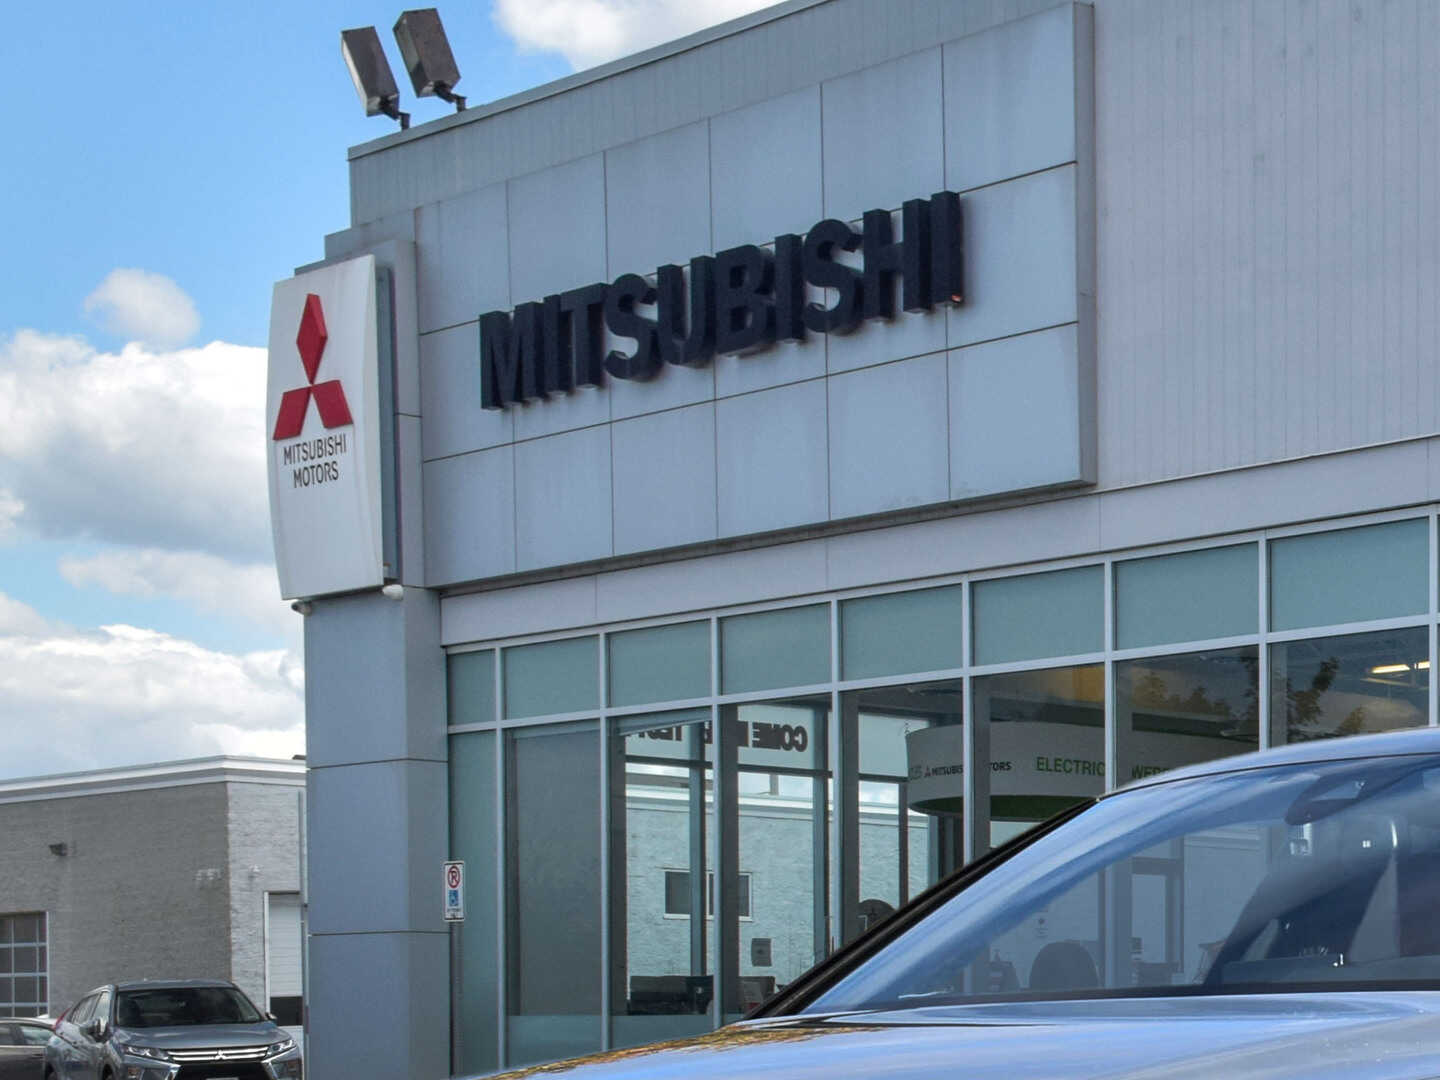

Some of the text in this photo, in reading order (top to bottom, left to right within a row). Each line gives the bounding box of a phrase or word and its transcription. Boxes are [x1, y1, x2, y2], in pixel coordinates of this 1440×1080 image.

[479, 191, 962, 410] MITSUBISHI
[283, 433, 346, 465] MITSUBISHI
[293, 460, 339, 488] MOTORS
